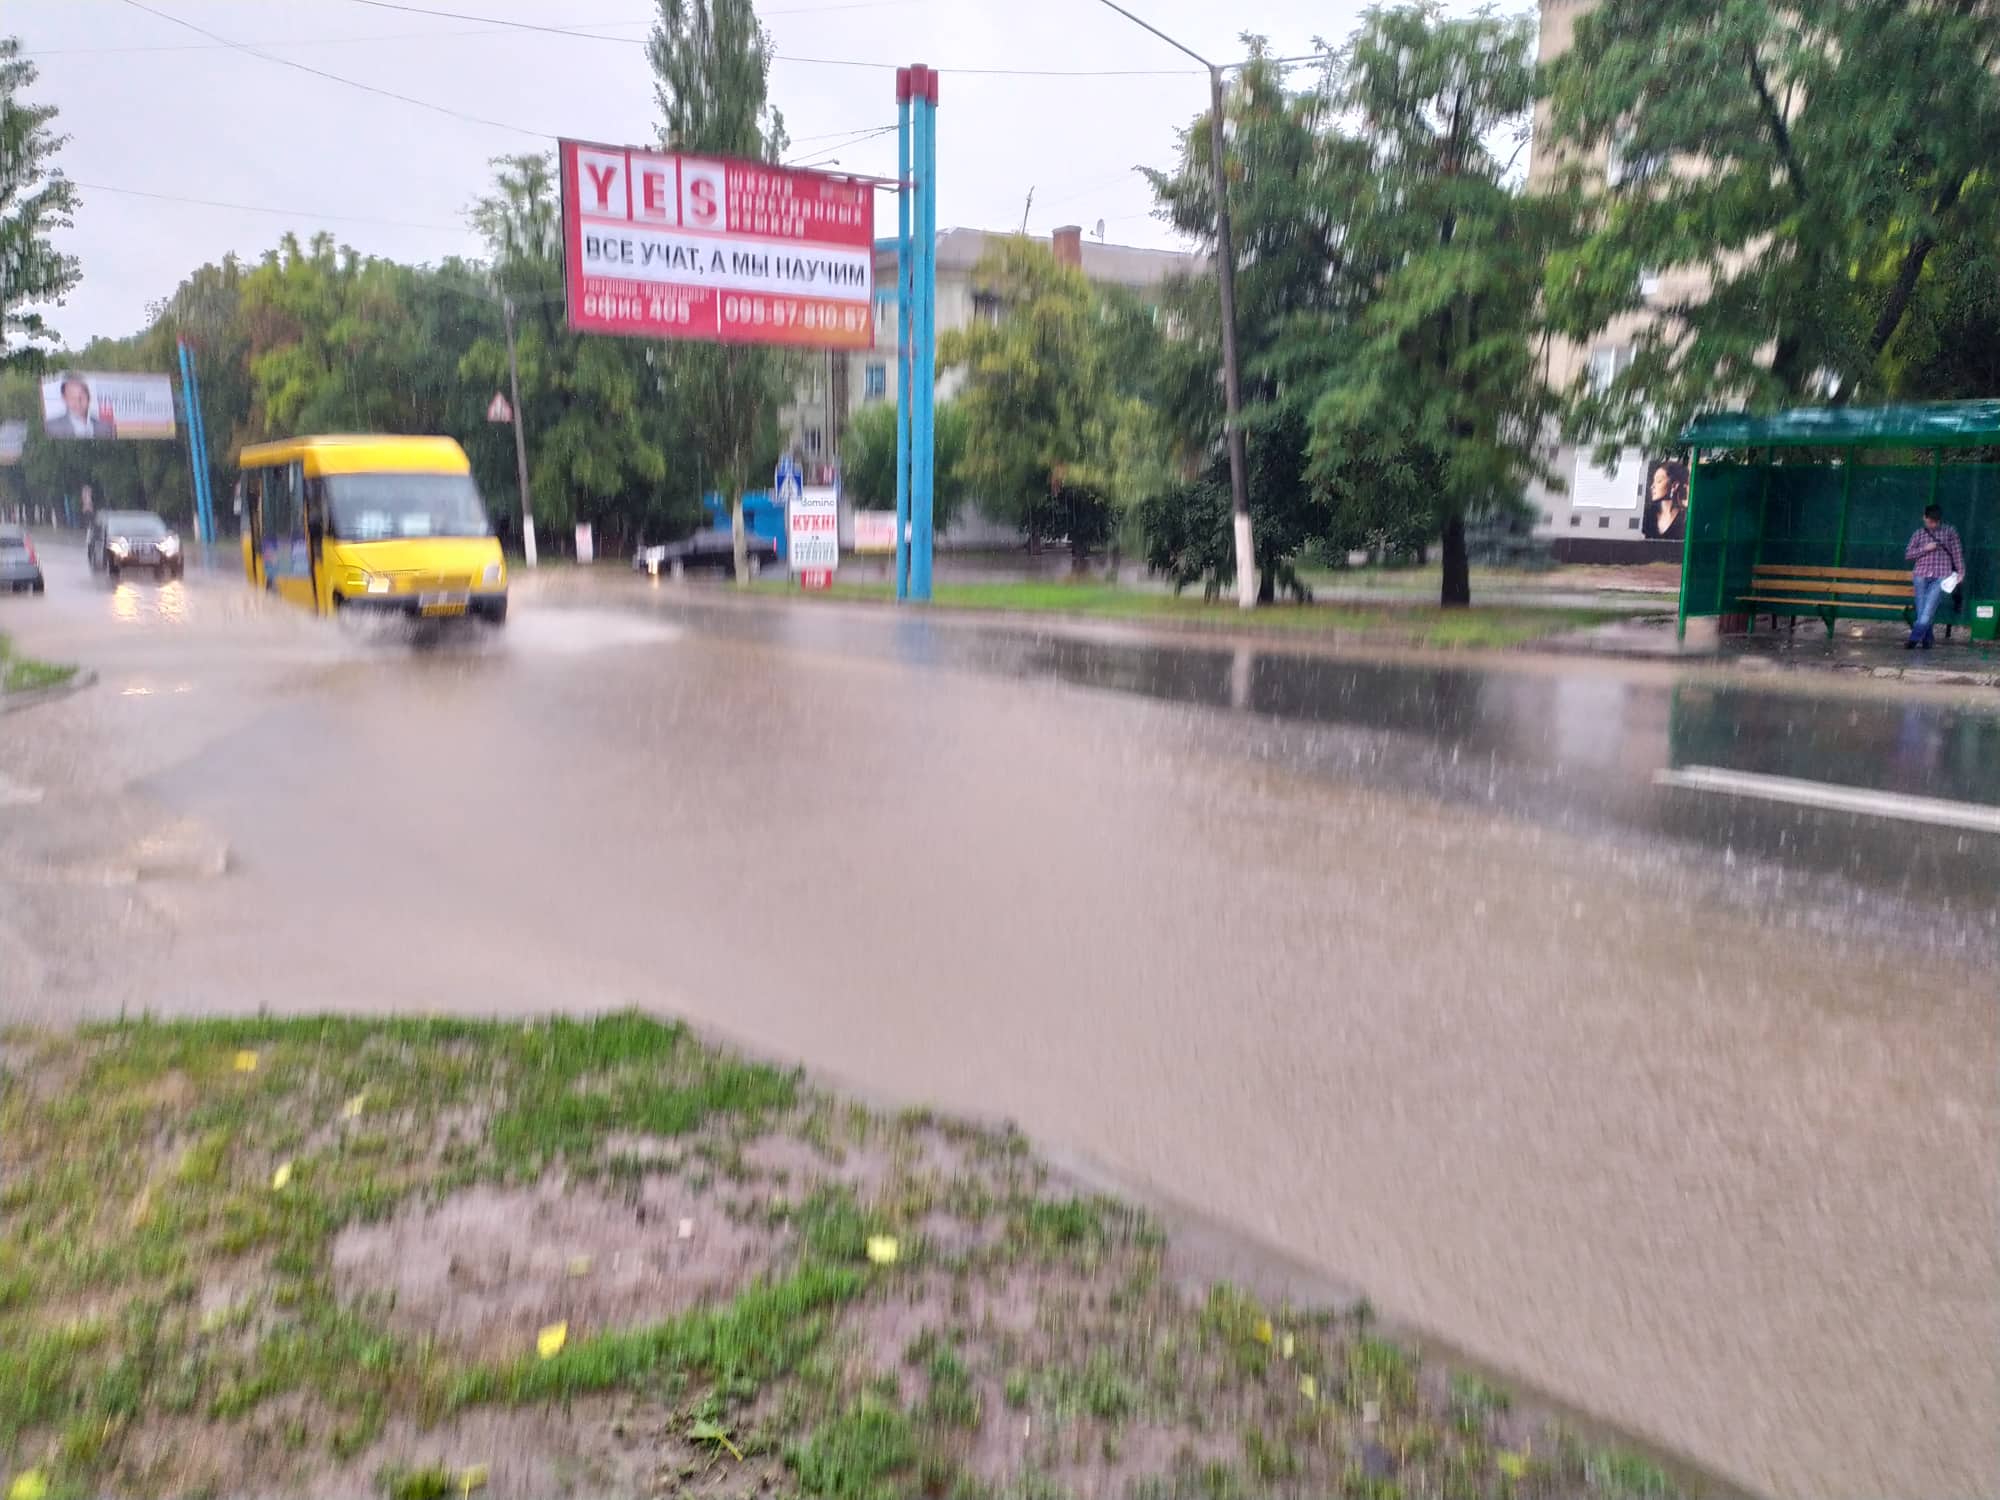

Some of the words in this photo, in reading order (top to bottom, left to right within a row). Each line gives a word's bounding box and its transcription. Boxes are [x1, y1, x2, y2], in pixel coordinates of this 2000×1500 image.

[585, 163, 718, 226] YES
[586, 235, 634, 264] ВСЕ
[641, 241, 704, 275] УЧАТ,
[711, 251, 726, 274] А
[733, 253, 769, 278] МЫ
[776, 257, 865, 287] НАУЧИМ
